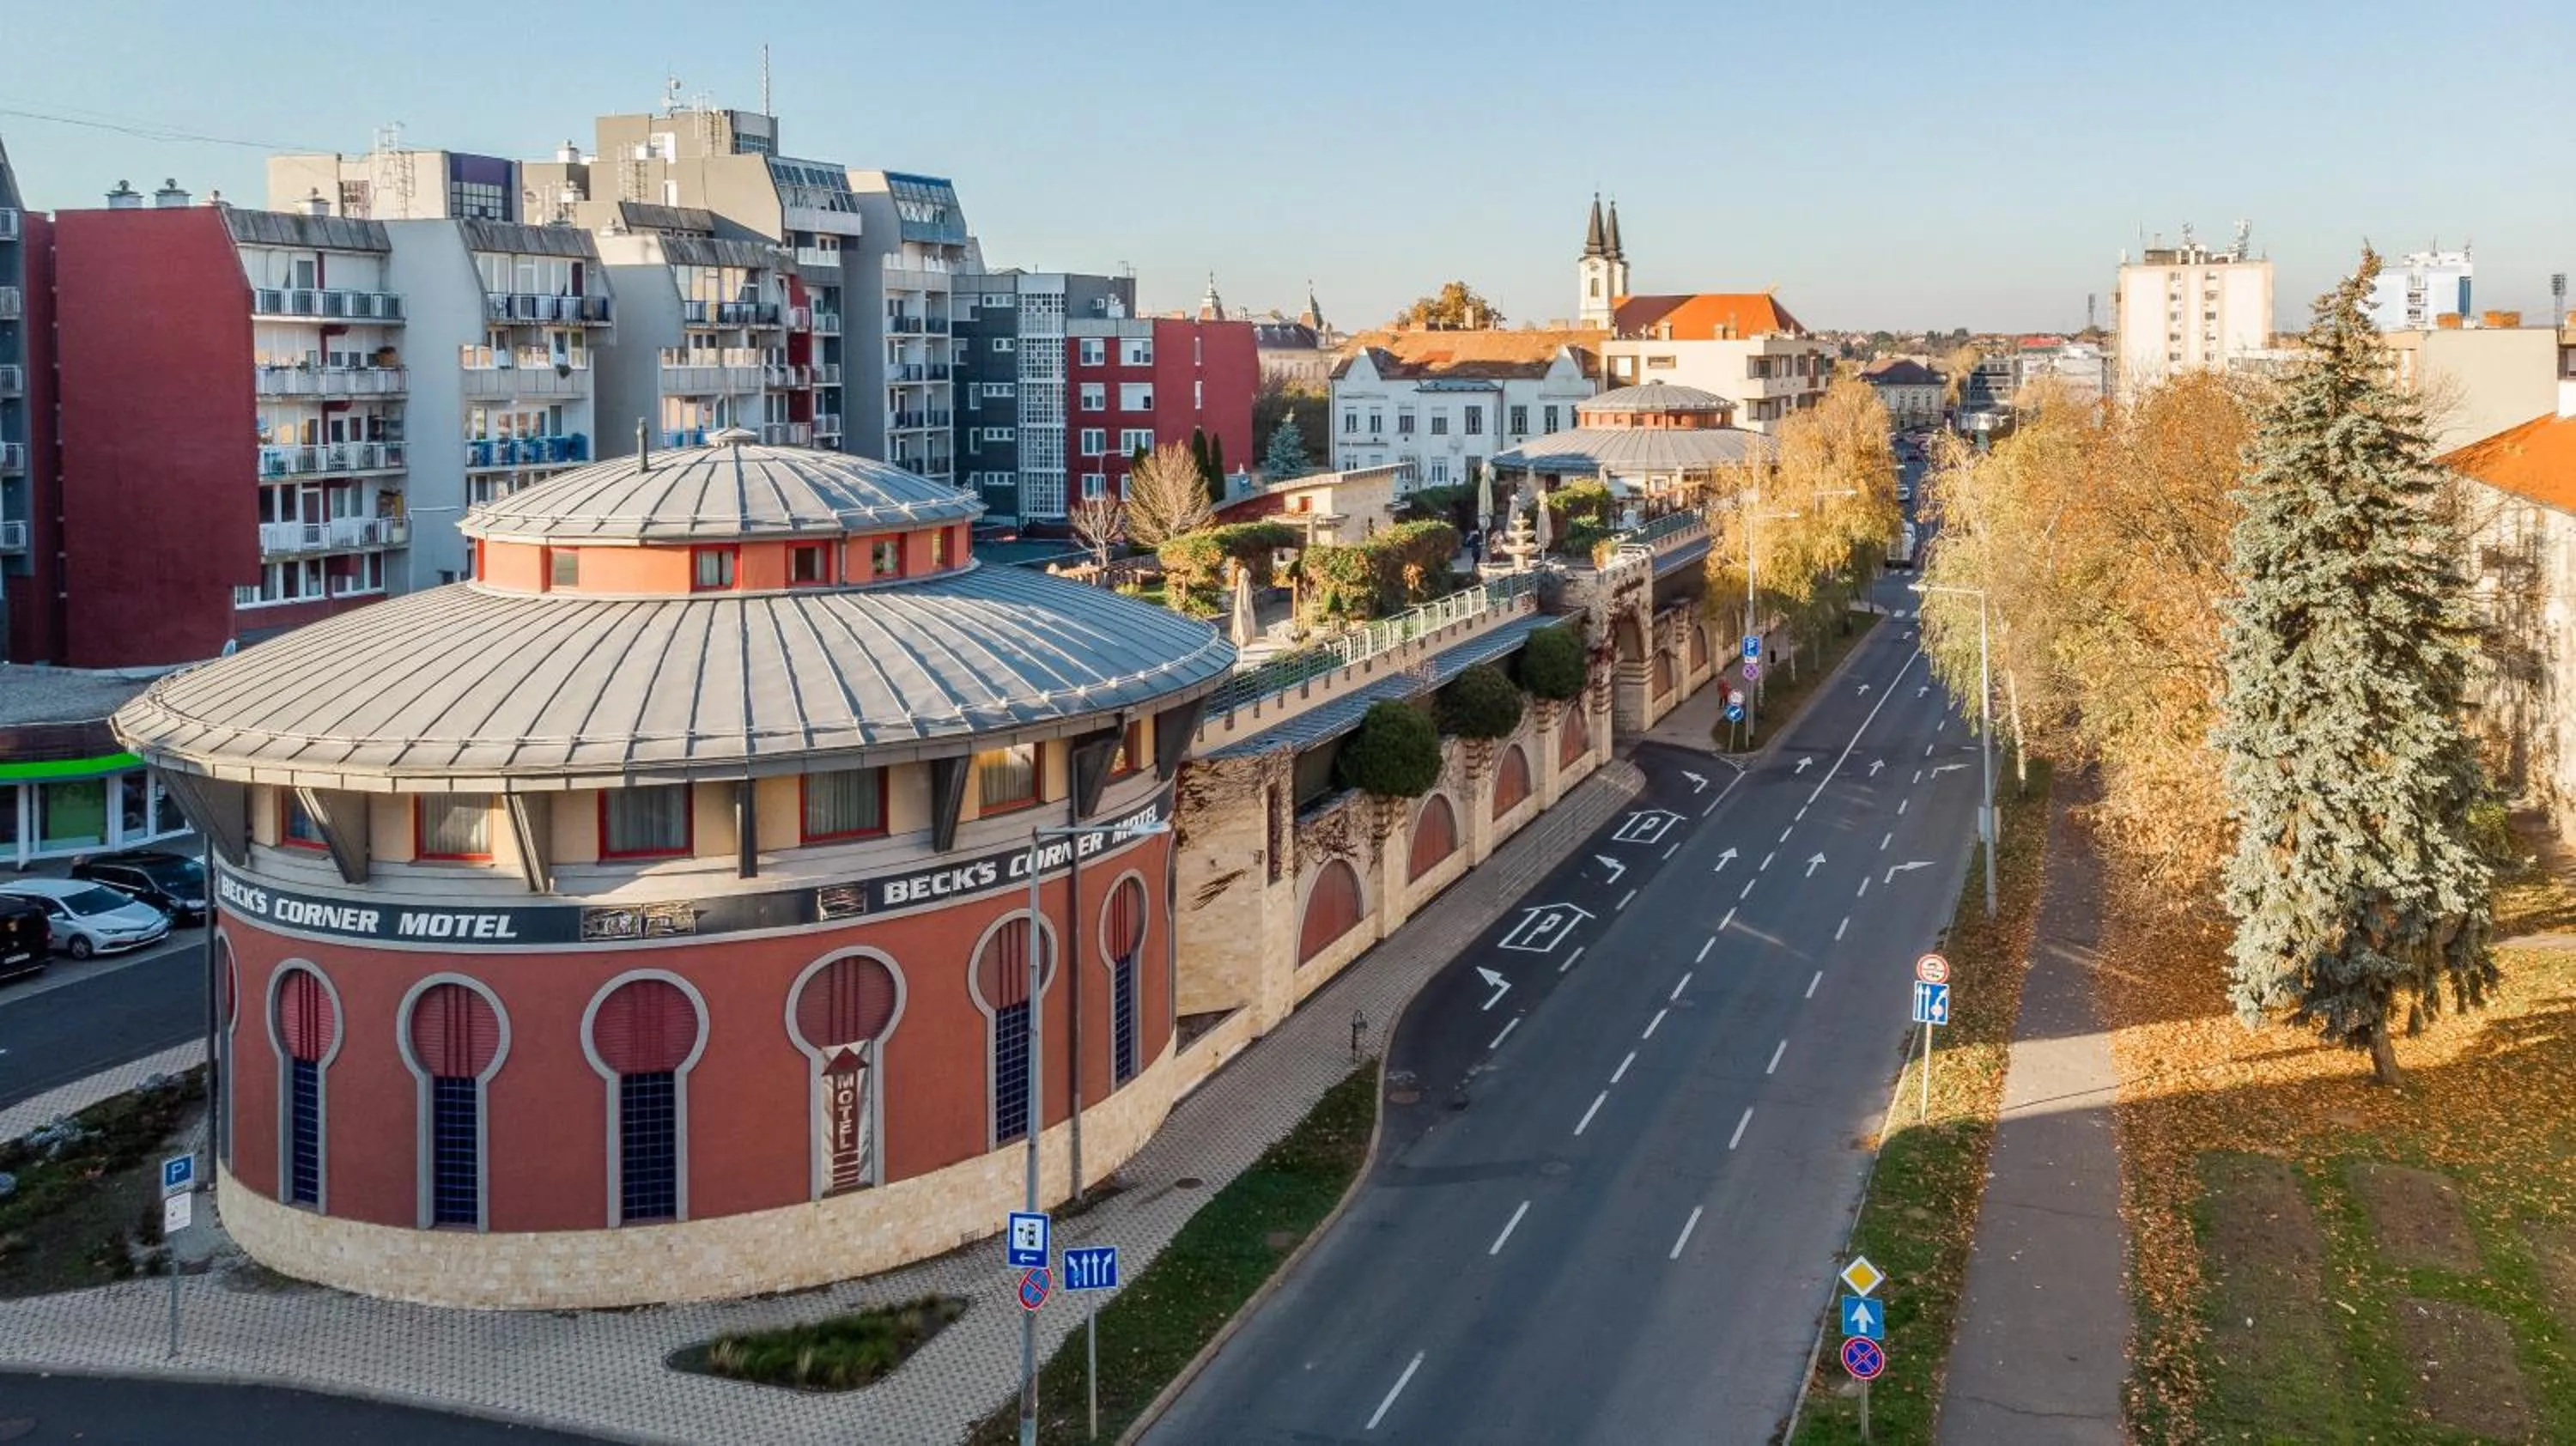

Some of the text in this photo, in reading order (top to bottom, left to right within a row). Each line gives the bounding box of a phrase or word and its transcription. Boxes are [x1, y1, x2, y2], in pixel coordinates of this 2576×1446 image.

[1630, 817, 1661, 838] P
[884, 860, 997, 905] BECK'S
[1009, 831, 1103, 878] CORNER
[221, 875, 518, 939] BECK'S CORNER MOTEL
[1522, 914, 1563, 945] P
[835, 1074, 854, 1150] MOTEL
[172, 1162, 185, 1182] P
